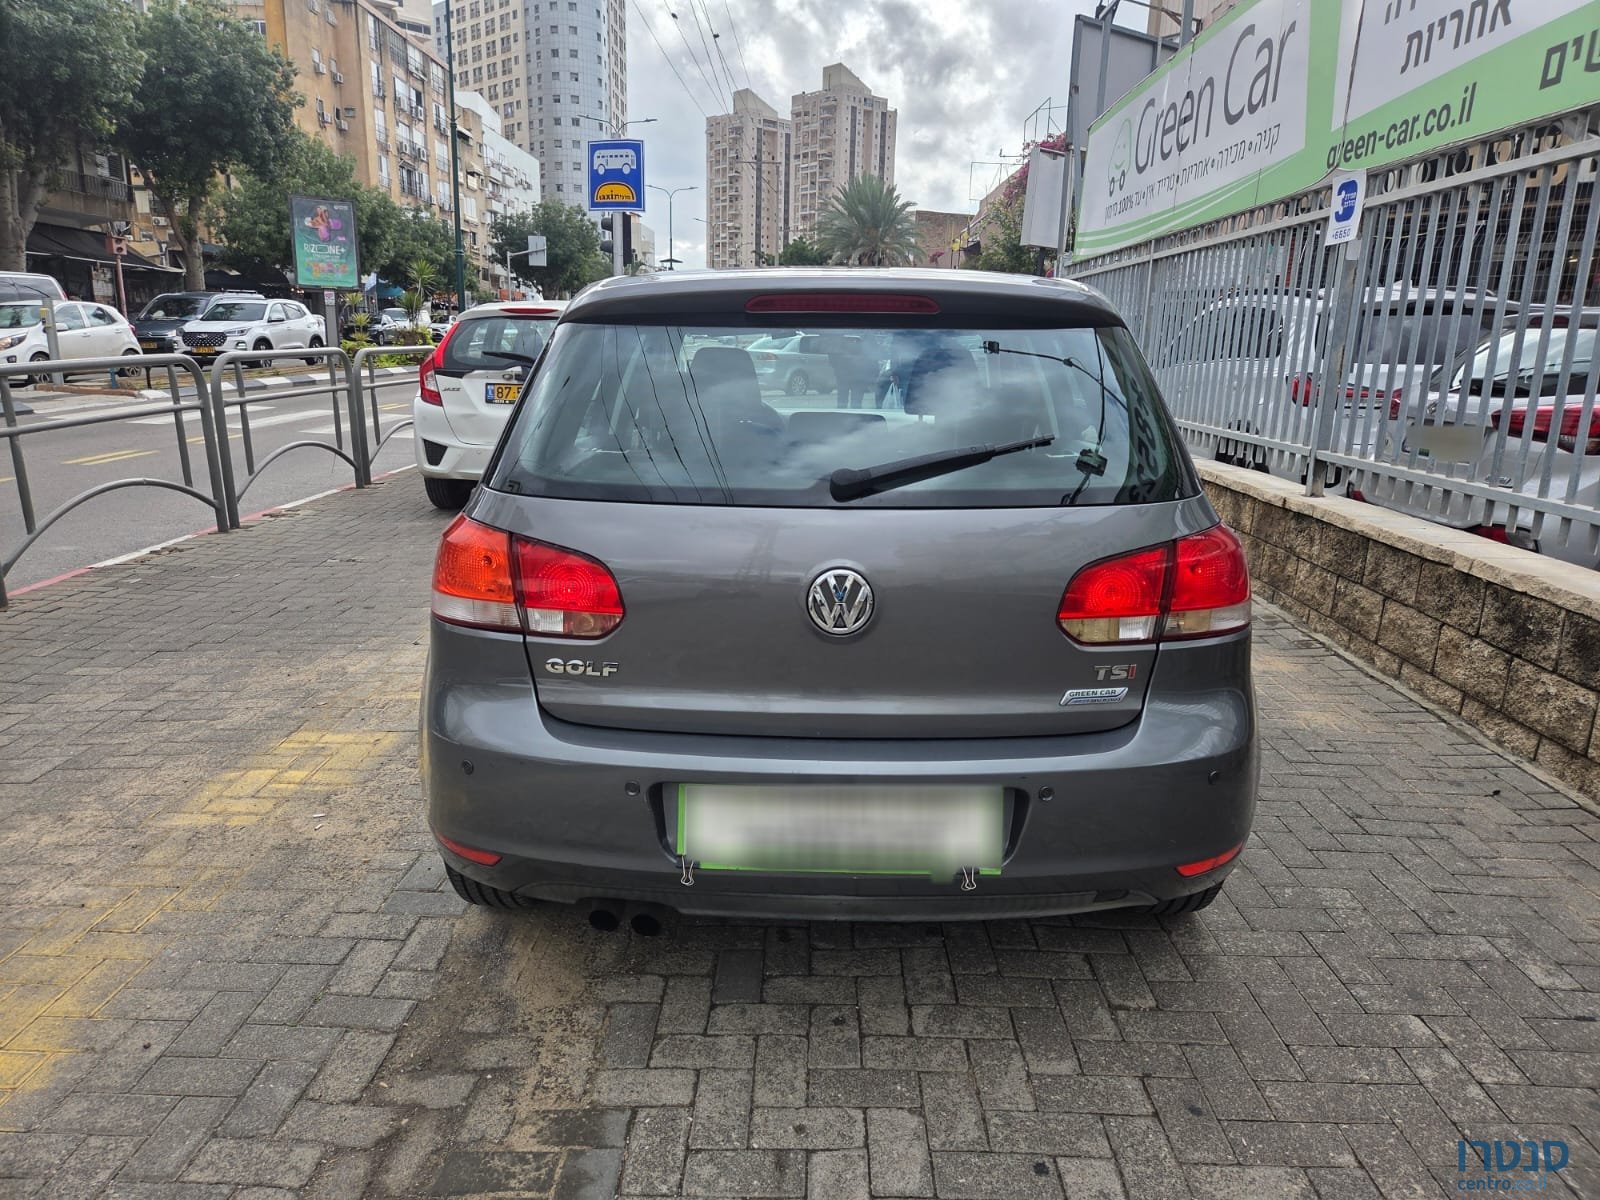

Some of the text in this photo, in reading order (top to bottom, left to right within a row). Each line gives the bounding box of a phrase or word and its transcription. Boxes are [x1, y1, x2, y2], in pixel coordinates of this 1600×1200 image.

[1400, 0, 1512, 75] אחריות
[1135, 20, 1297, 175] Green Car
[1254, 123, 1281, 155] קניה
[1217, 140, 1246, 171] מכירה
[1180, 160, 1209, 187] אחריות
[545, 657, 619, 677] GOLF
[1069, 690, 1098, 698] GREEN
